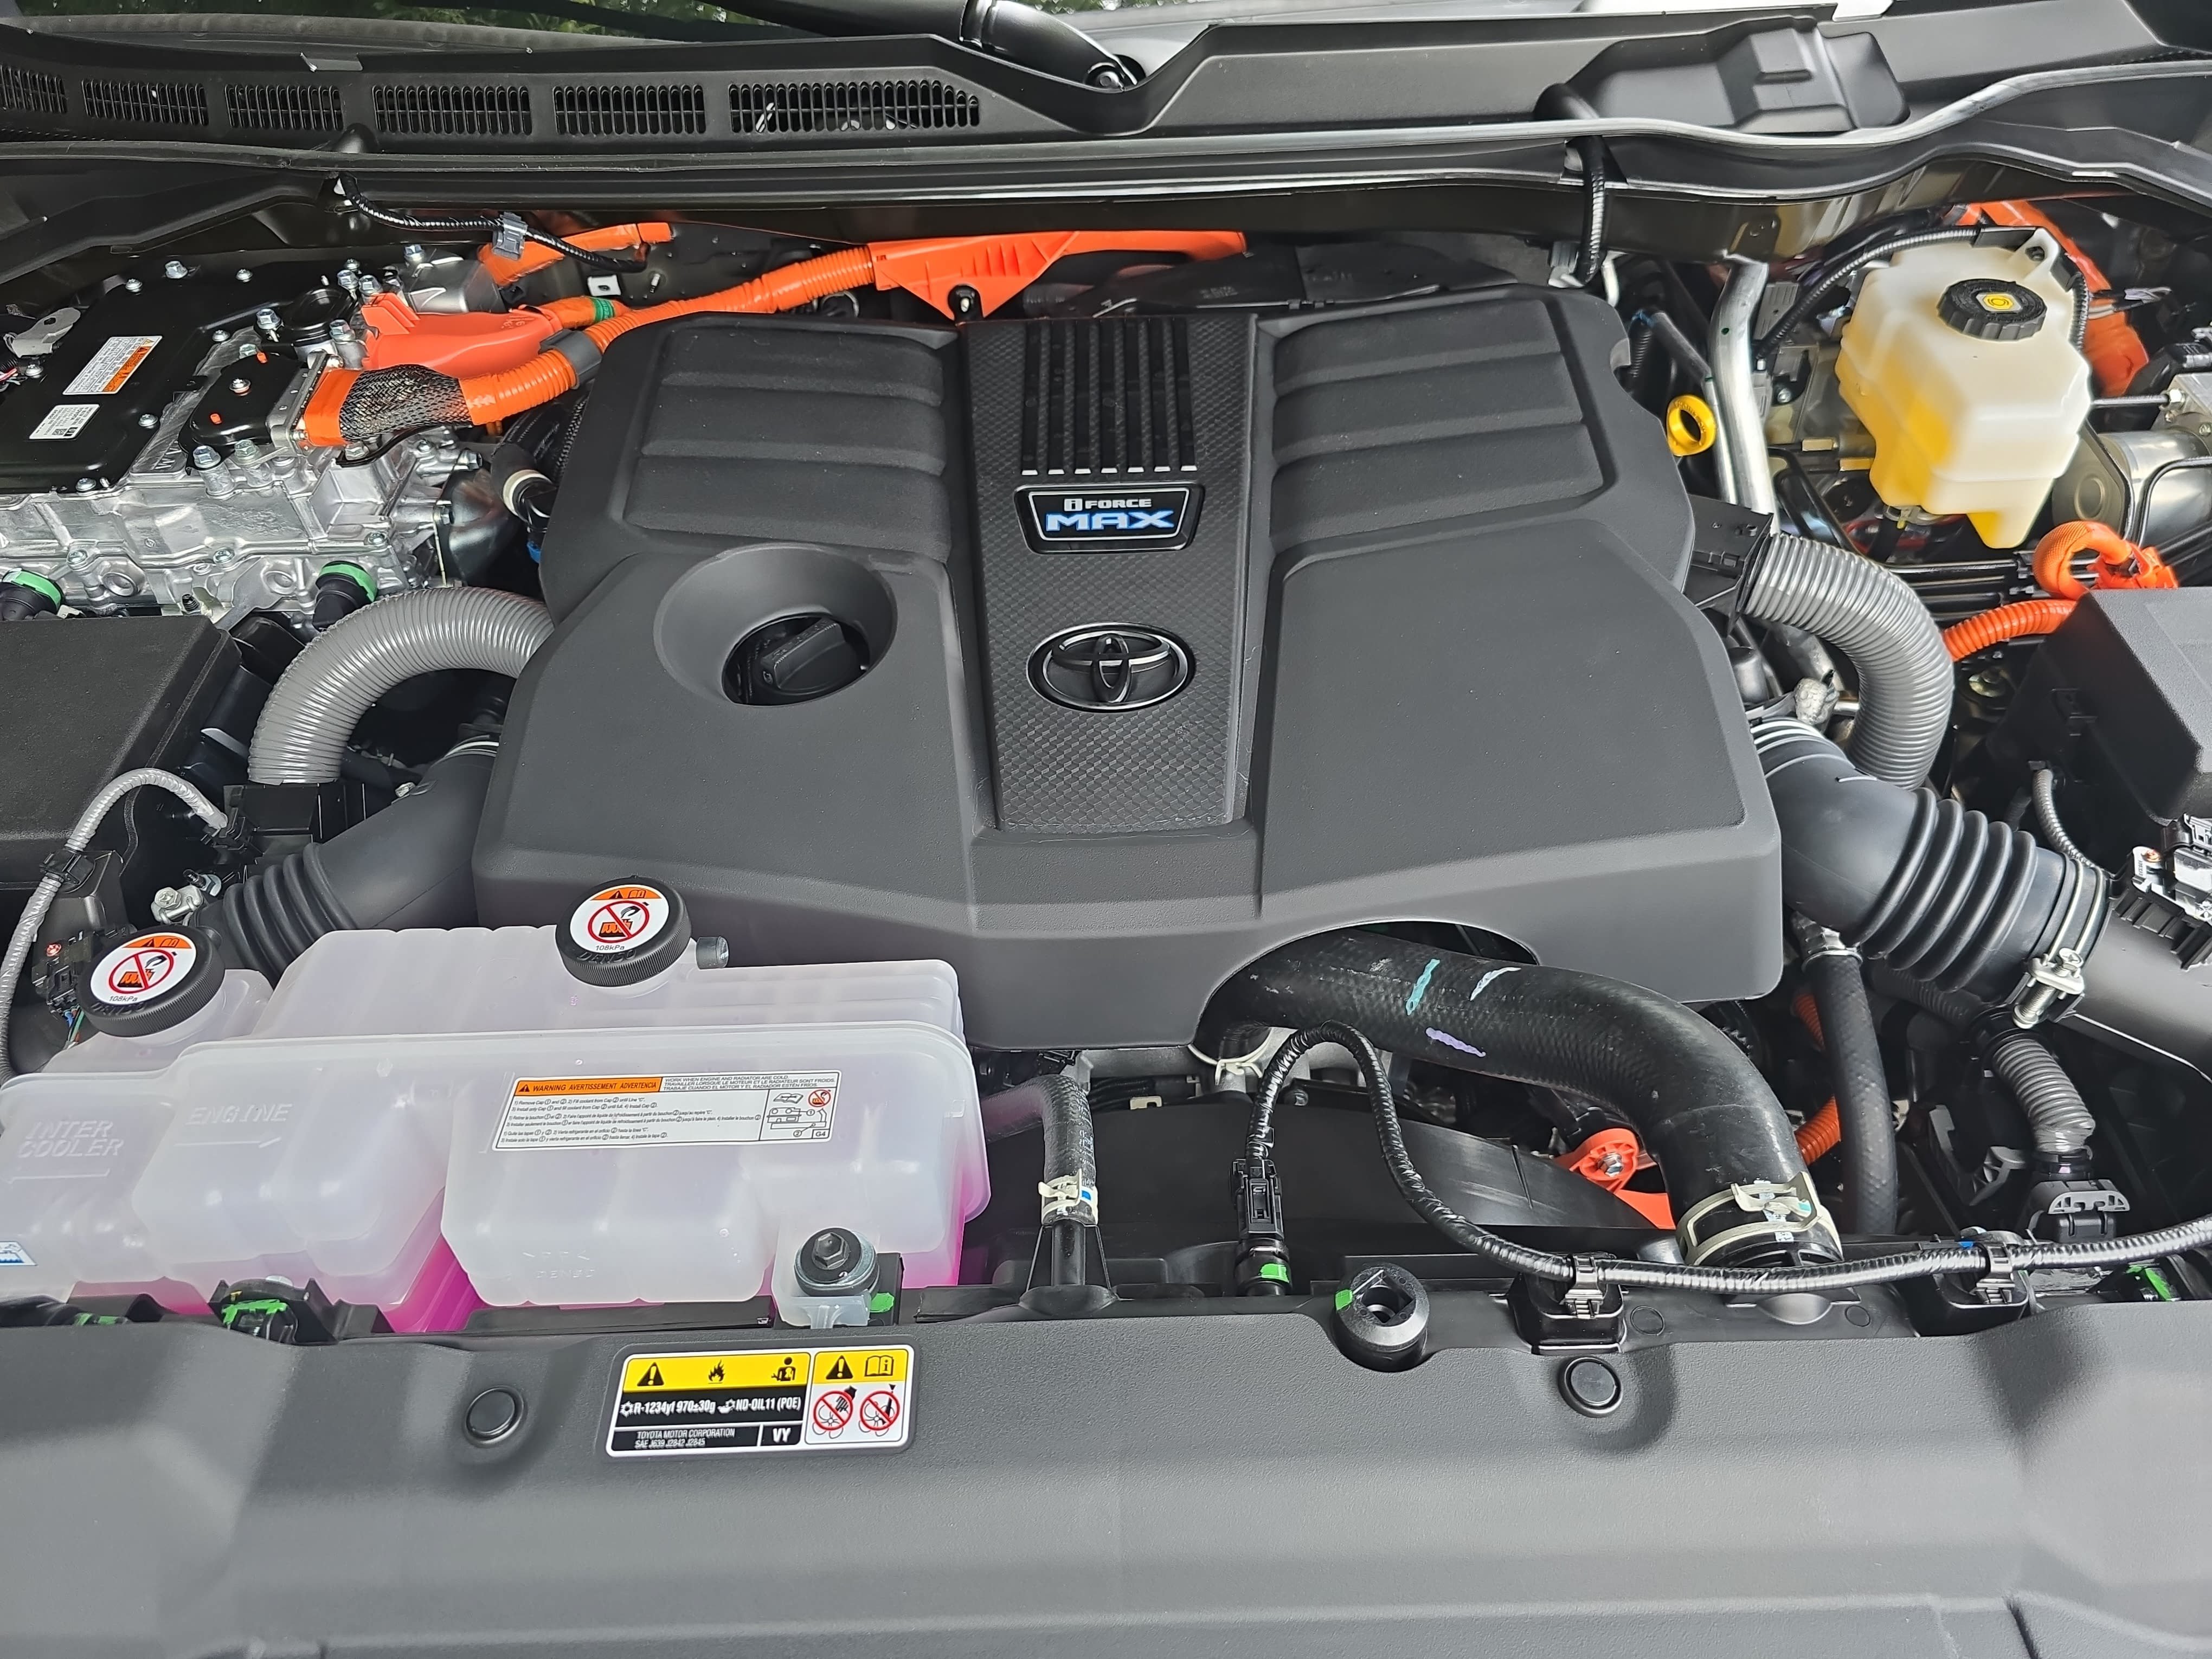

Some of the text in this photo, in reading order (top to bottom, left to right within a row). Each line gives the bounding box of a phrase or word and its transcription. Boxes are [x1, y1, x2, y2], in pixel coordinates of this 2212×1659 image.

[1085, 498, 1152, 509] FORCE
[1045, 510, 1175, 531] MAX
[185, 1104, 293, 1126] ENGINE
[26, 1120, 113, 1139] INTER
[17, 1139, 124, 1158] COOLER
[633, 1397, 801, 1416] R-1234yf 970±30g ND-OIL11 (POE)
[637, 1428, 736, 1439] TOYOTA MOTOR CORPORATION
[773, 1427, 791, 1443] VY
[635, 1438, 705, 1449] SAE J639 J2842 J2845
